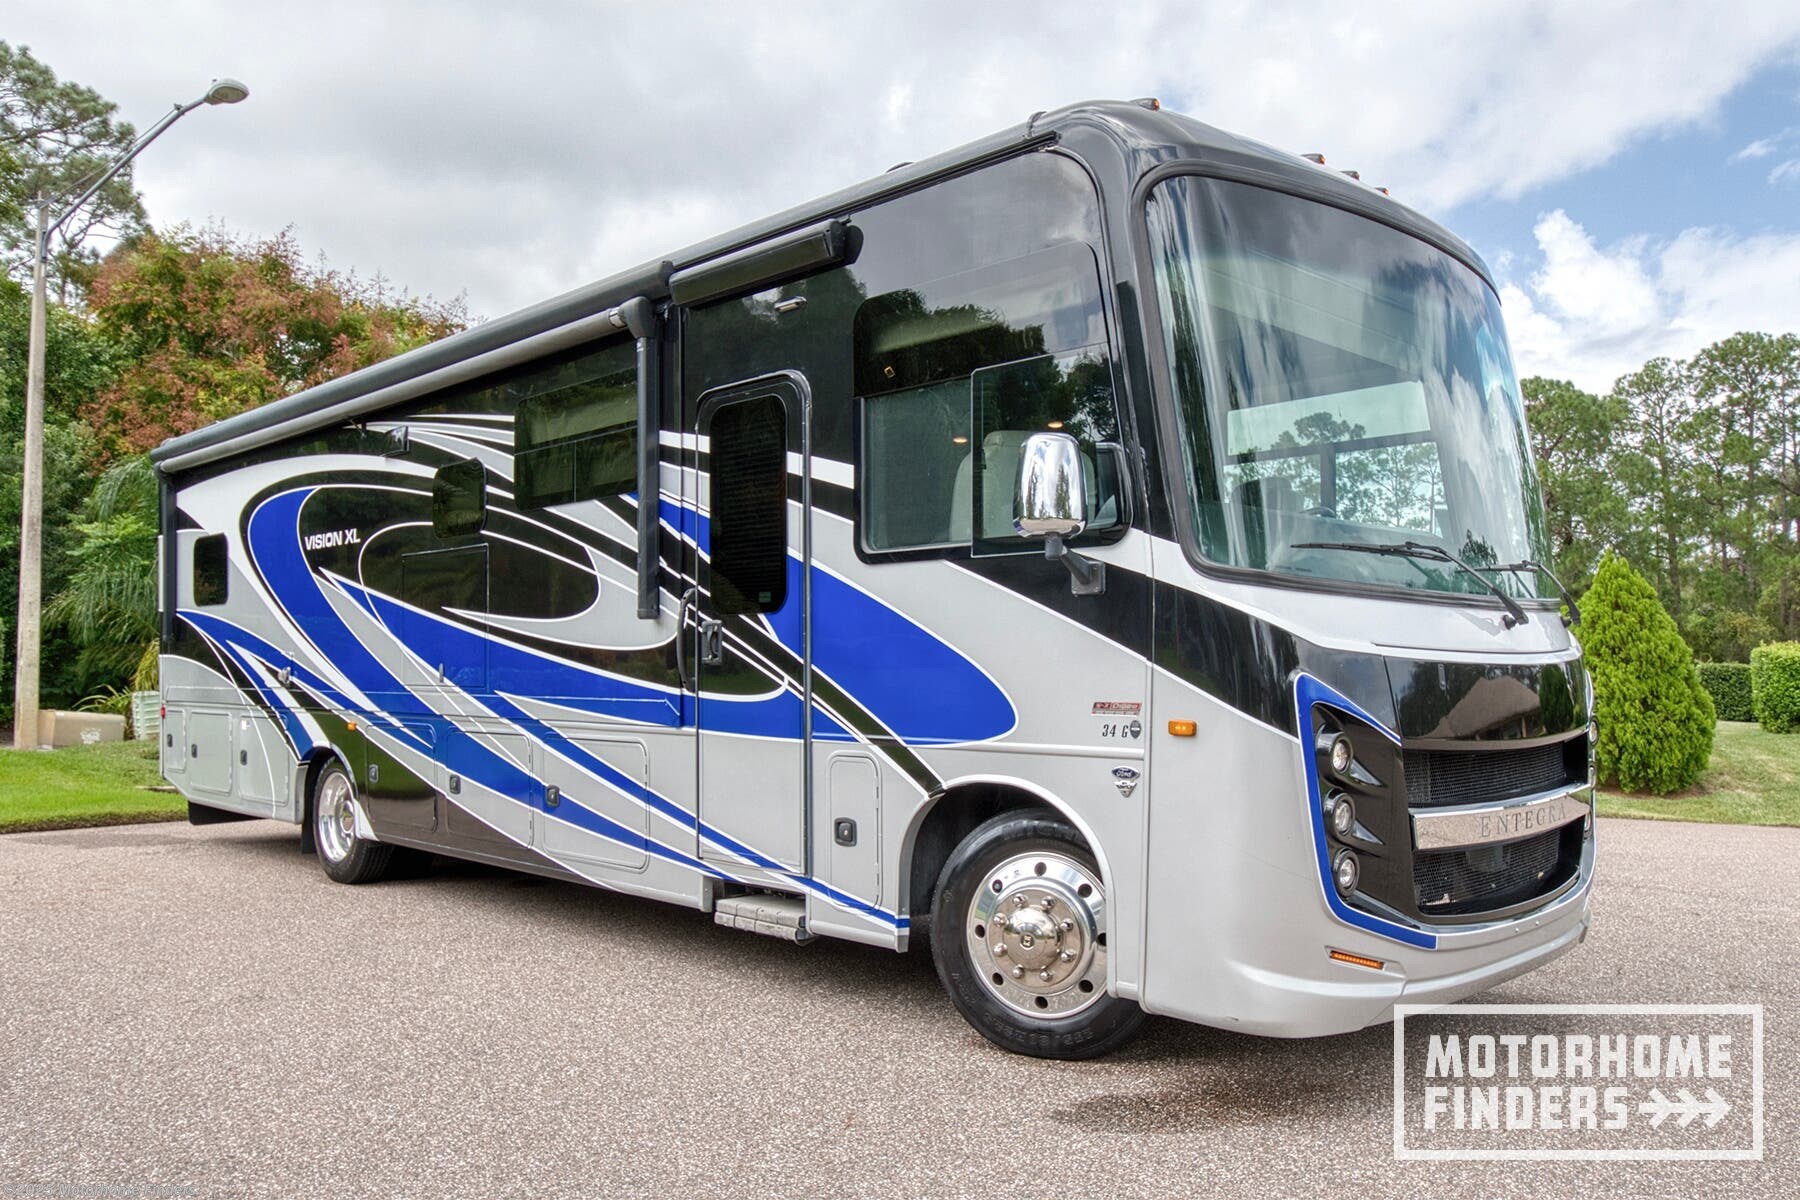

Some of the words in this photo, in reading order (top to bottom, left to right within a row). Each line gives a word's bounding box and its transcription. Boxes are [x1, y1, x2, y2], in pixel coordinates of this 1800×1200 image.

[304, 531, 343, 550] VISION
[344, 528, 361, 544] XL
[1102, 724, 1116, 737] 34
[1121, 725, 1129, 738] G
[1480, 802, 1566, 837] ENTEGRA
